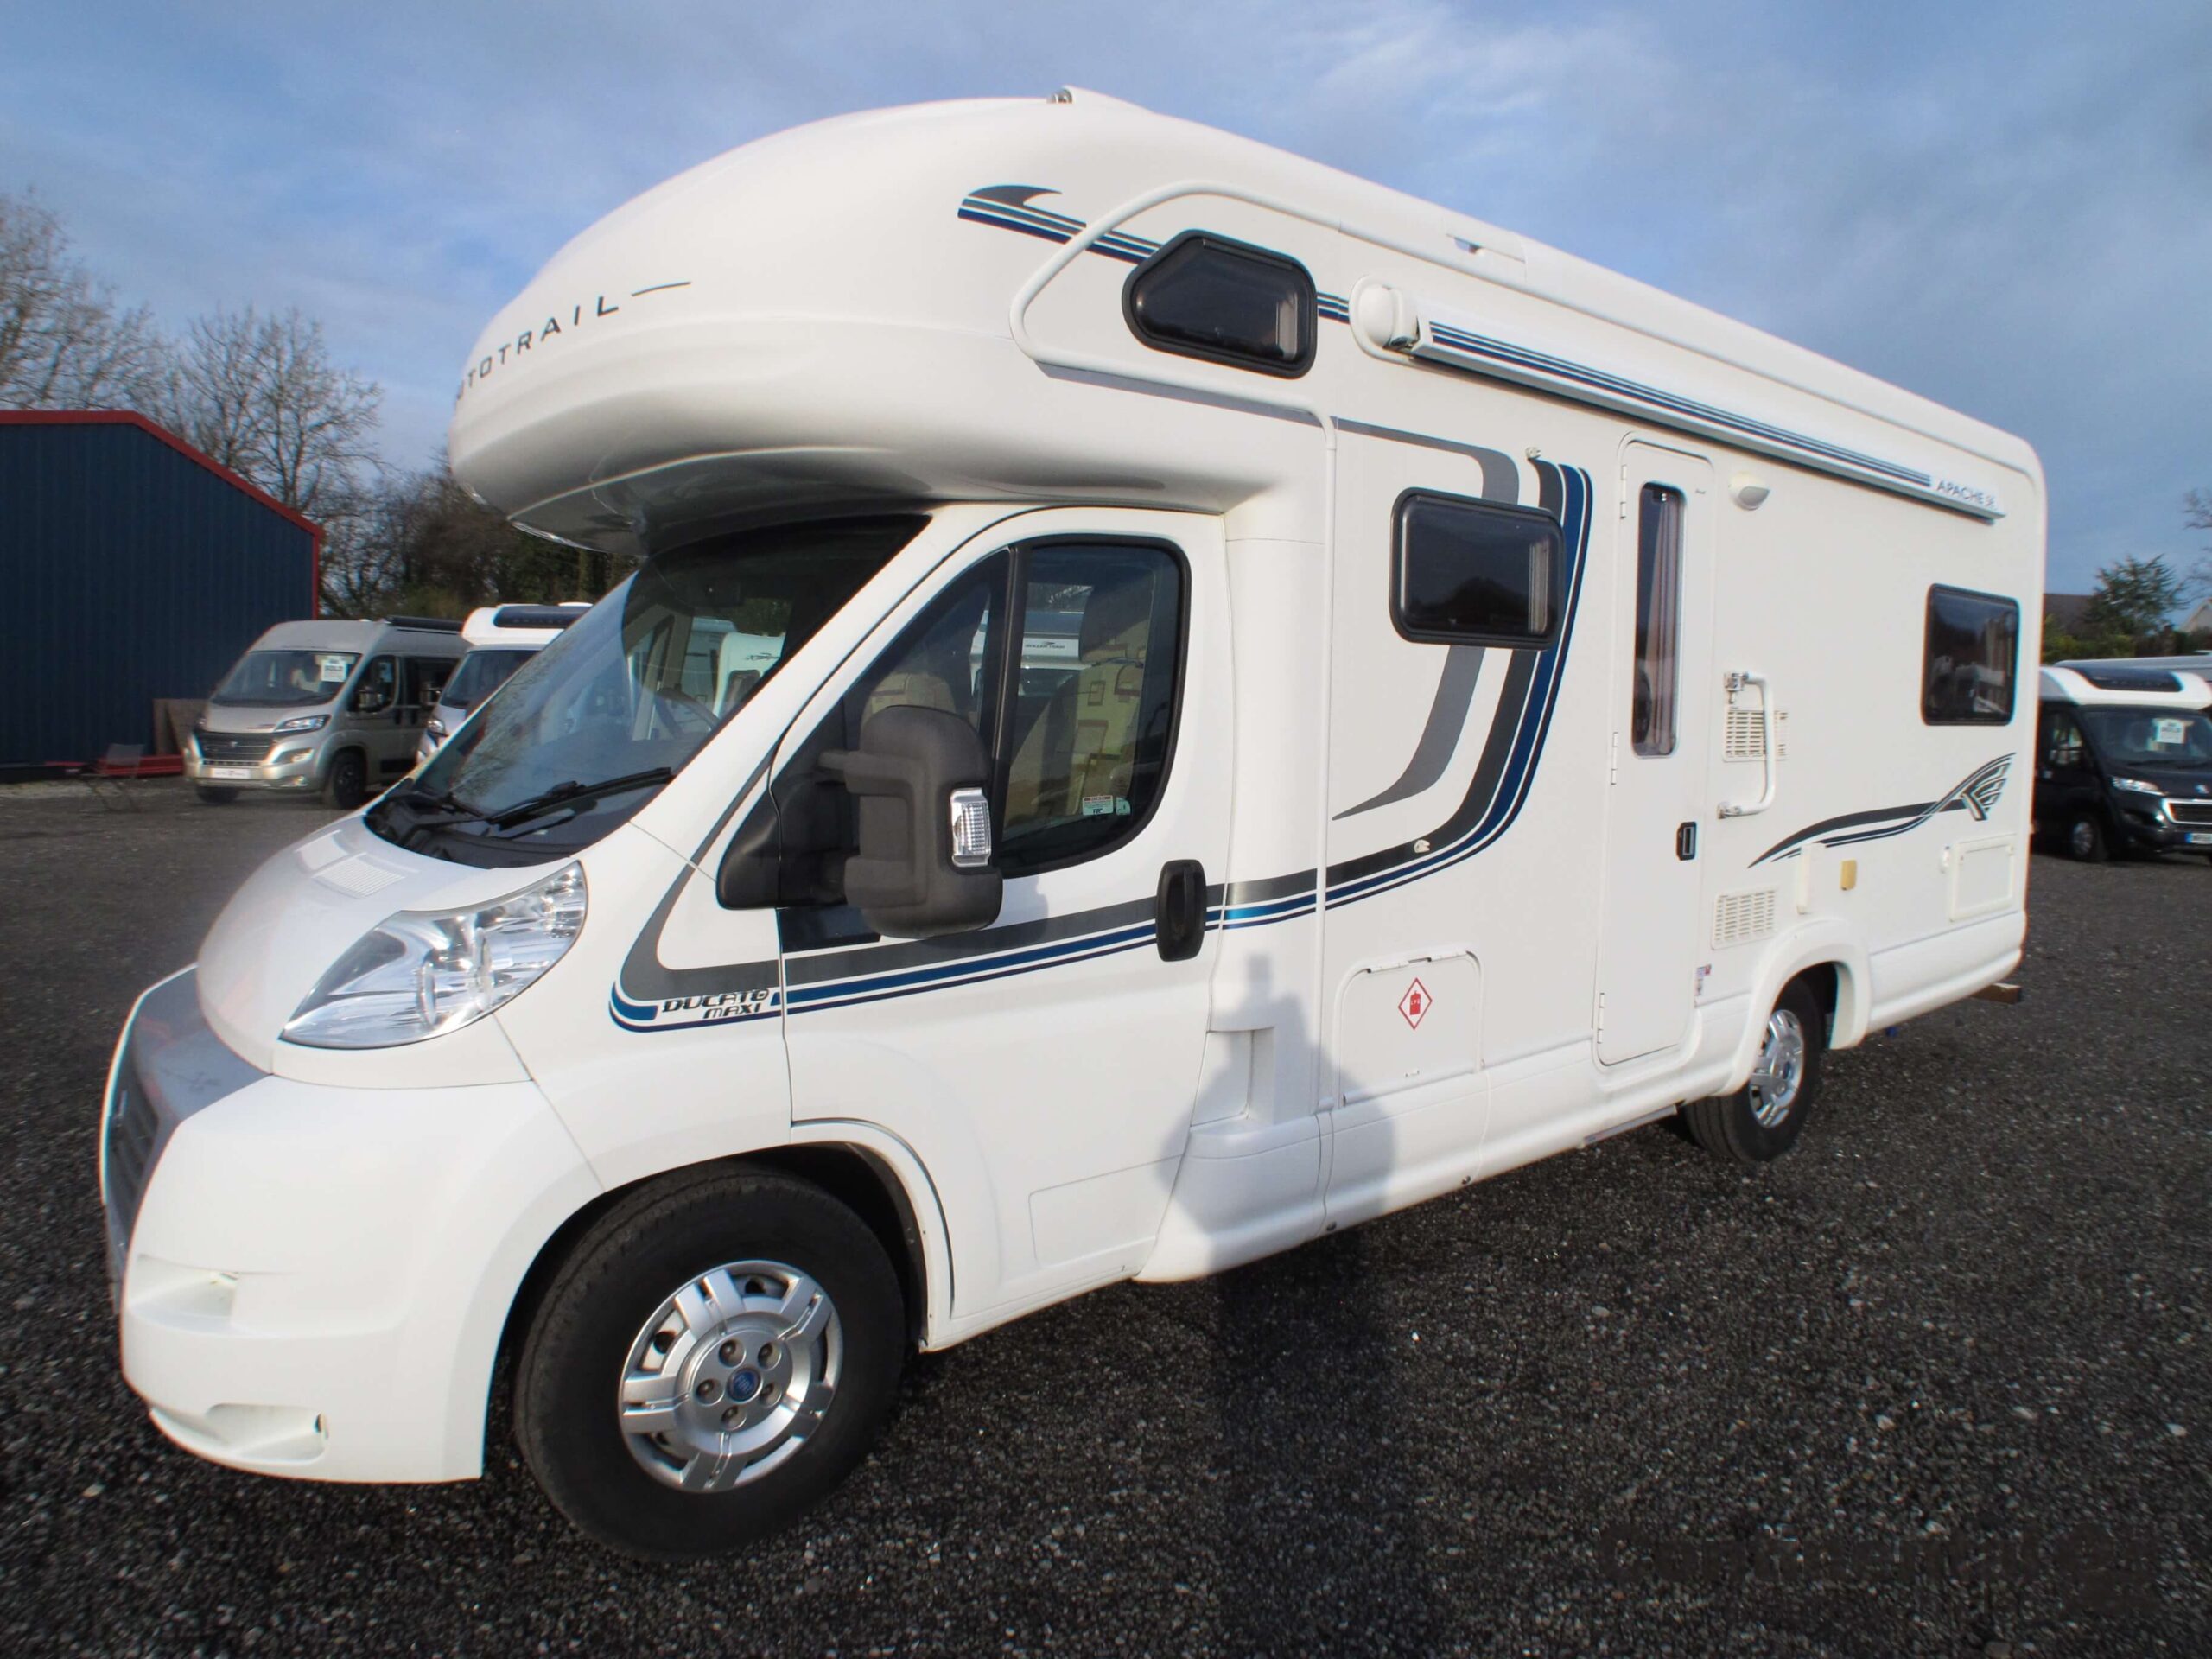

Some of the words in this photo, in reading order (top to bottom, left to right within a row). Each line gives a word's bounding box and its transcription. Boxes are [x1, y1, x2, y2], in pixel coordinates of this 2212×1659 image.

[1936, 480, 1984, 504] APACHE
[662, 988, 769, 1013] DUCATO
[703, 1002, 761, 1019] MAXI
